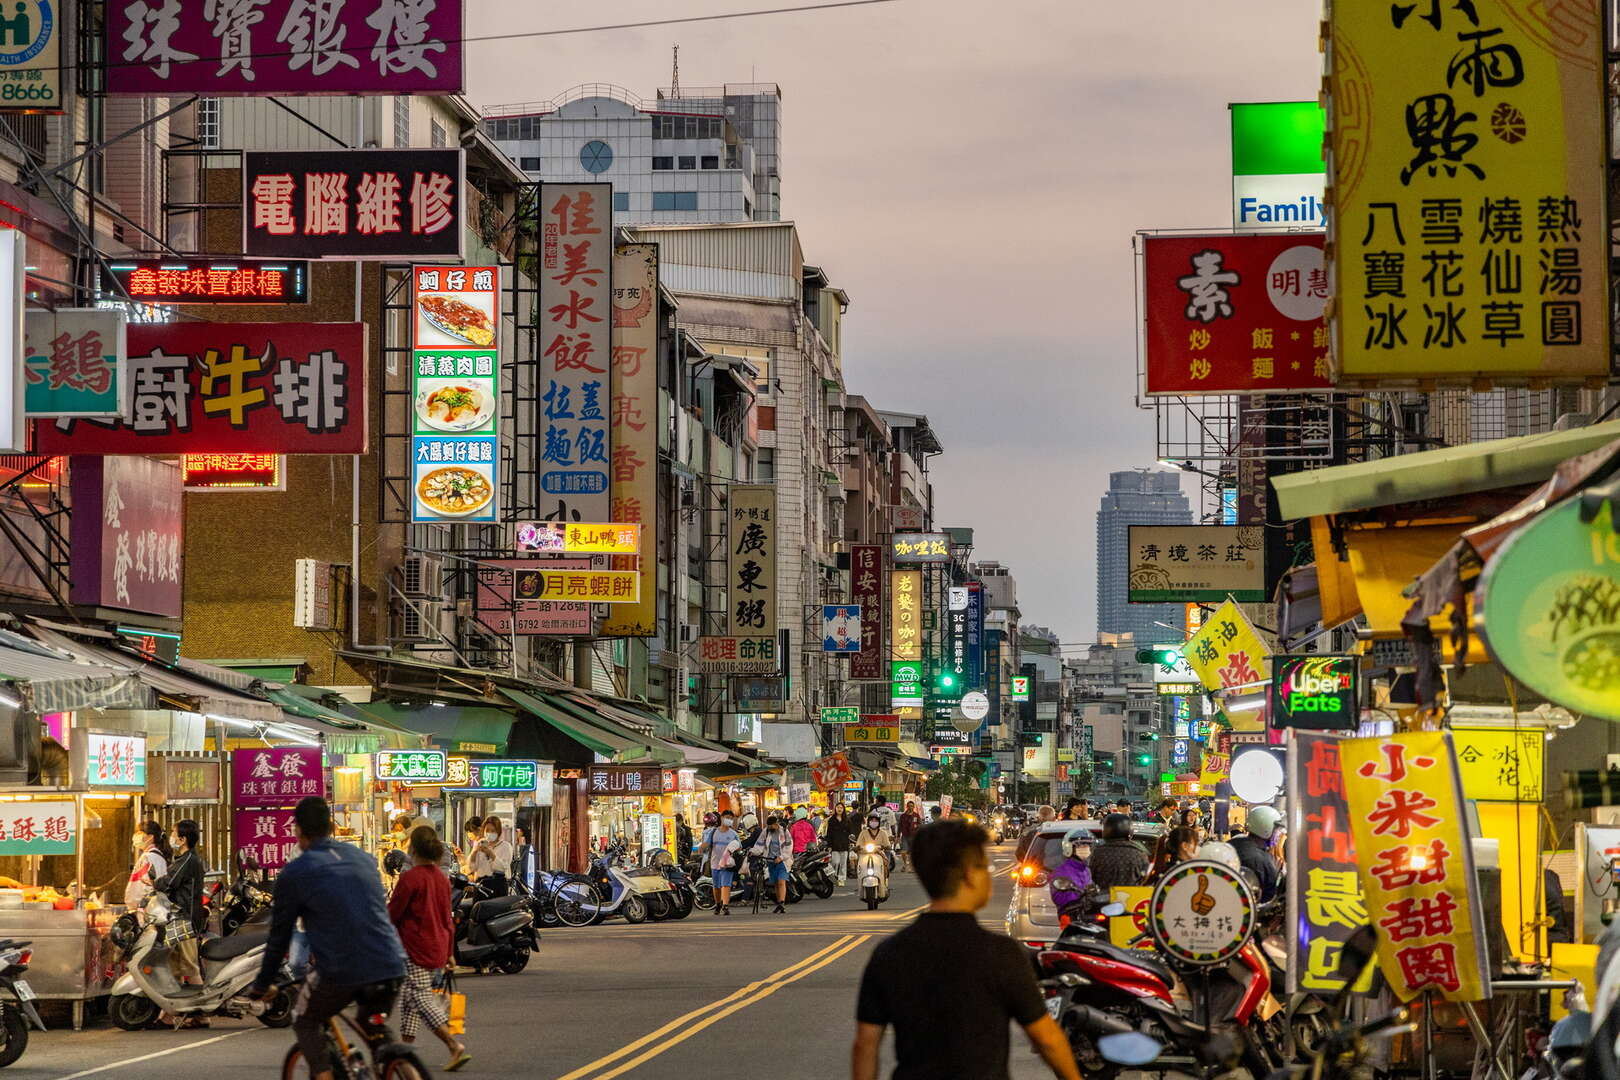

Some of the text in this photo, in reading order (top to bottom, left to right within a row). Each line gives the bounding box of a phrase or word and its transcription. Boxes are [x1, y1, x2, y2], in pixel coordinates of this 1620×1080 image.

[122, 0, 448, 82] 珠寶銀樓
[2, 83, 54, 100] 8666
[252, 172, 454, 237] 電腦維修
[131, 269, 282, 296] 鑫發珠寶銀樓
[419, 271, 493, 291] 蚵仔煎
[544, 191, 608, 374] 佳美水餃
[1362, 202, 1408, 350] 八寶冰
[1421, 199, 1466, 349] 雪花冰
[1478, 197, 1524, 348] 燒仙草
[1538, 196, 1583, 347] 熱湯圓
[1177, 250, 1239, 324] 素
[419, 356, 493, 376] 清蒸肉圓
[56, 341, 346, 431] 廚牛排
[417, 442, 493, 462] 大腸蚵仔麵線
[569, 528, 636, 547] 東山鴨頭
[895, 540, 948, 557] 咖哩飯
[1140, 544, 1247, 562] 清境茶莊
[545, 576, 632, 597] 月亮蝦餅
[735, 523, 768, 629] 廣東粥
[702, 639, 774, 659] 地理 命相
[1291, 673, 1341, 693] Uber
[1290, 692, 1342, 712] Eats
[251, 752, 307, 778] 鑫發
[241, 779, 317, 795] 珠寶銀樓
[1358, 743, 1461, 992] 小米甜甜圈
